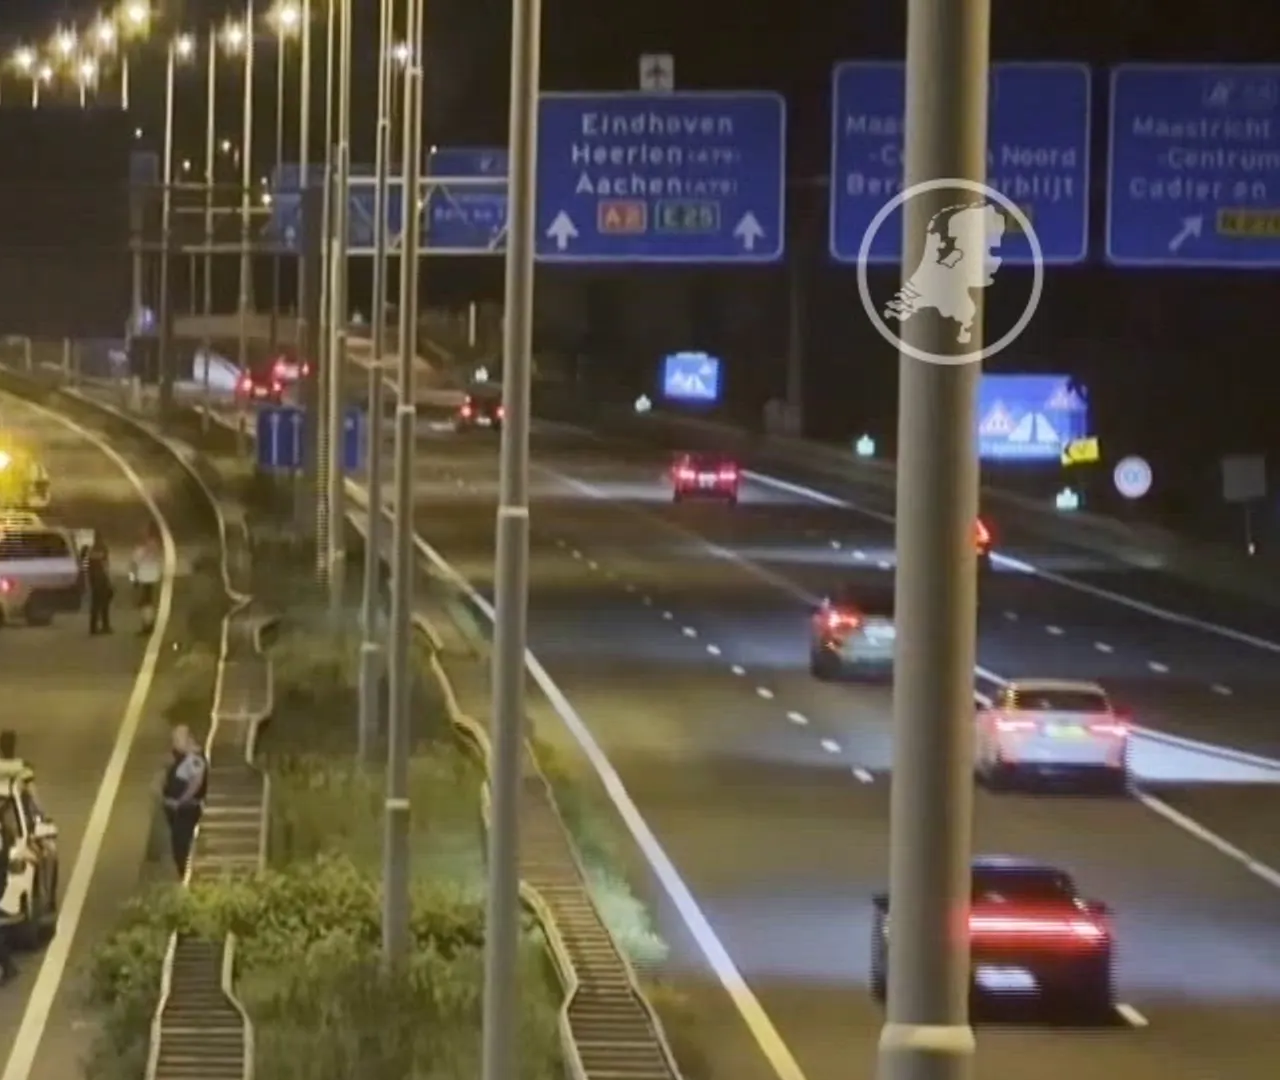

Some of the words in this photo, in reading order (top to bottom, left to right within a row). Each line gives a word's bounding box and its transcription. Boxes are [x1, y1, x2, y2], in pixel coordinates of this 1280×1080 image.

[581, 112, 734, 137] Eindhoven
[1133, 115, 1271, 140] Maastricht
[571, 143, 683, 166] Heerlen
[1001, 144, 1077, 169] Noord
[575, 170, 682, 195] Aachen
[846, 172, 904, 198] Ber
[1233, 180, 1267, 200] en
